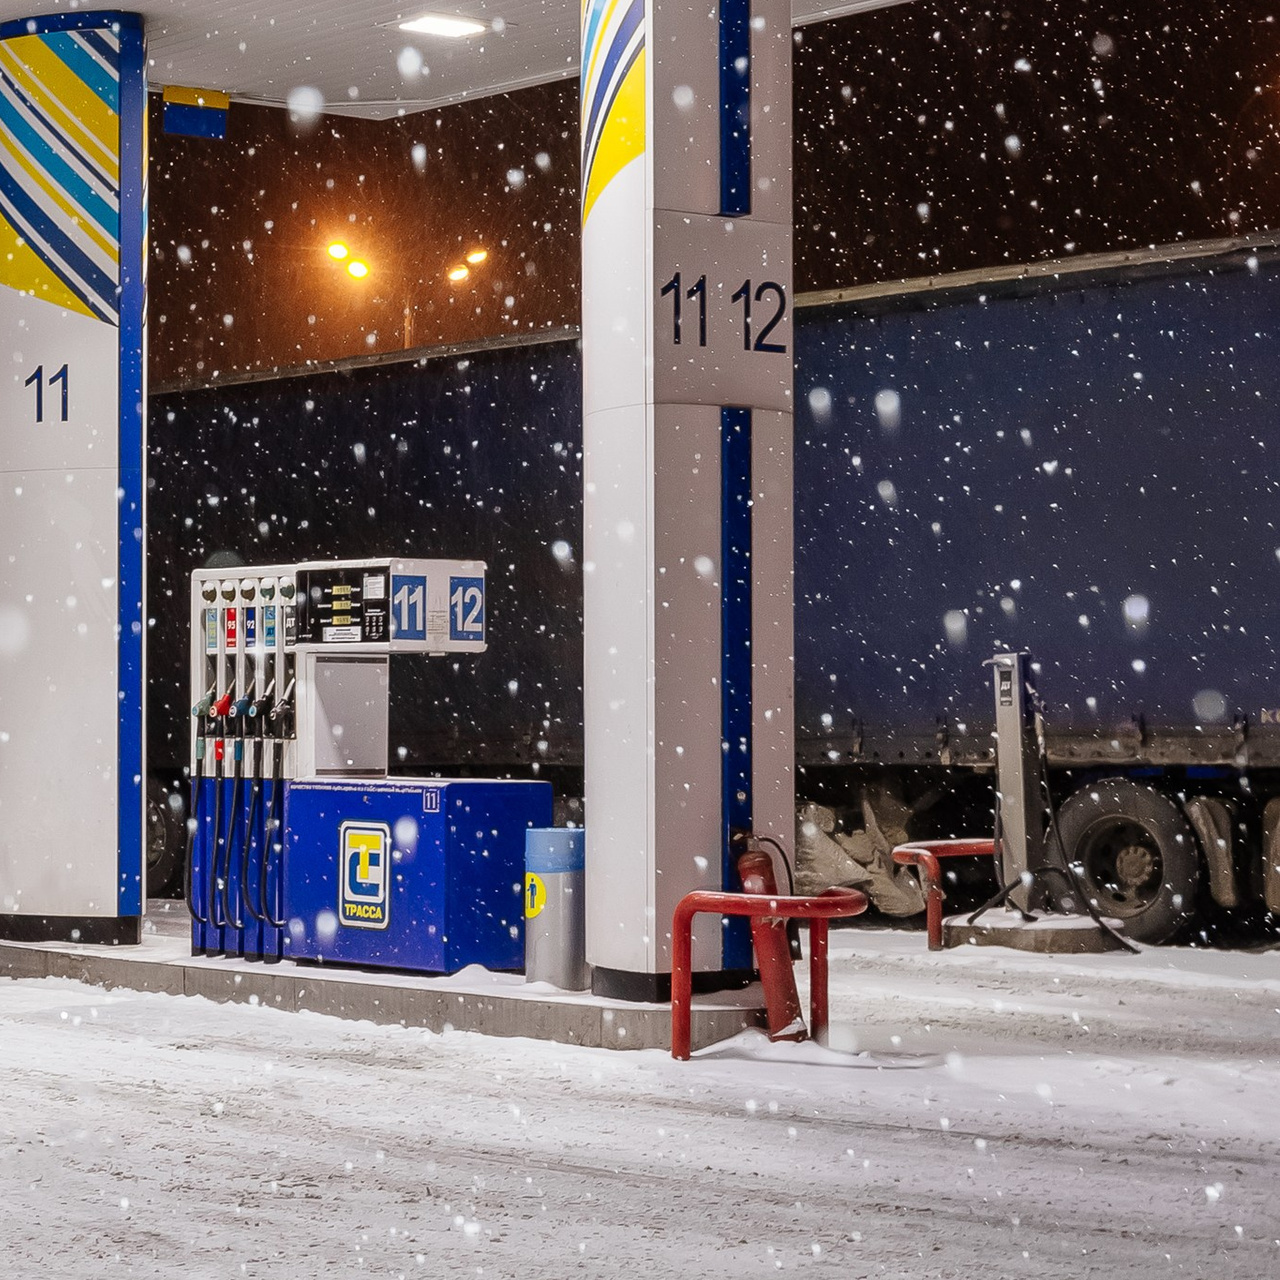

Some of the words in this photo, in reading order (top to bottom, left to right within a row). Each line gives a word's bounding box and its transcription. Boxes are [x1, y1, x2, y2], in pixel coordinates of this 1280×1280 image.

[660, 271, 707, 347] 11
[731, 278, 787, 354] 12
[24, 364, 69, 423] 11
[394, 585, 424, 631] 11
[451, 586, 483, 632] 12
[227, 620, 236, 630] 95
[246, 620, 255, 629] 92
[425, 793, 436, 808] 11
[344, 903, 382, 919] ТРАССА
